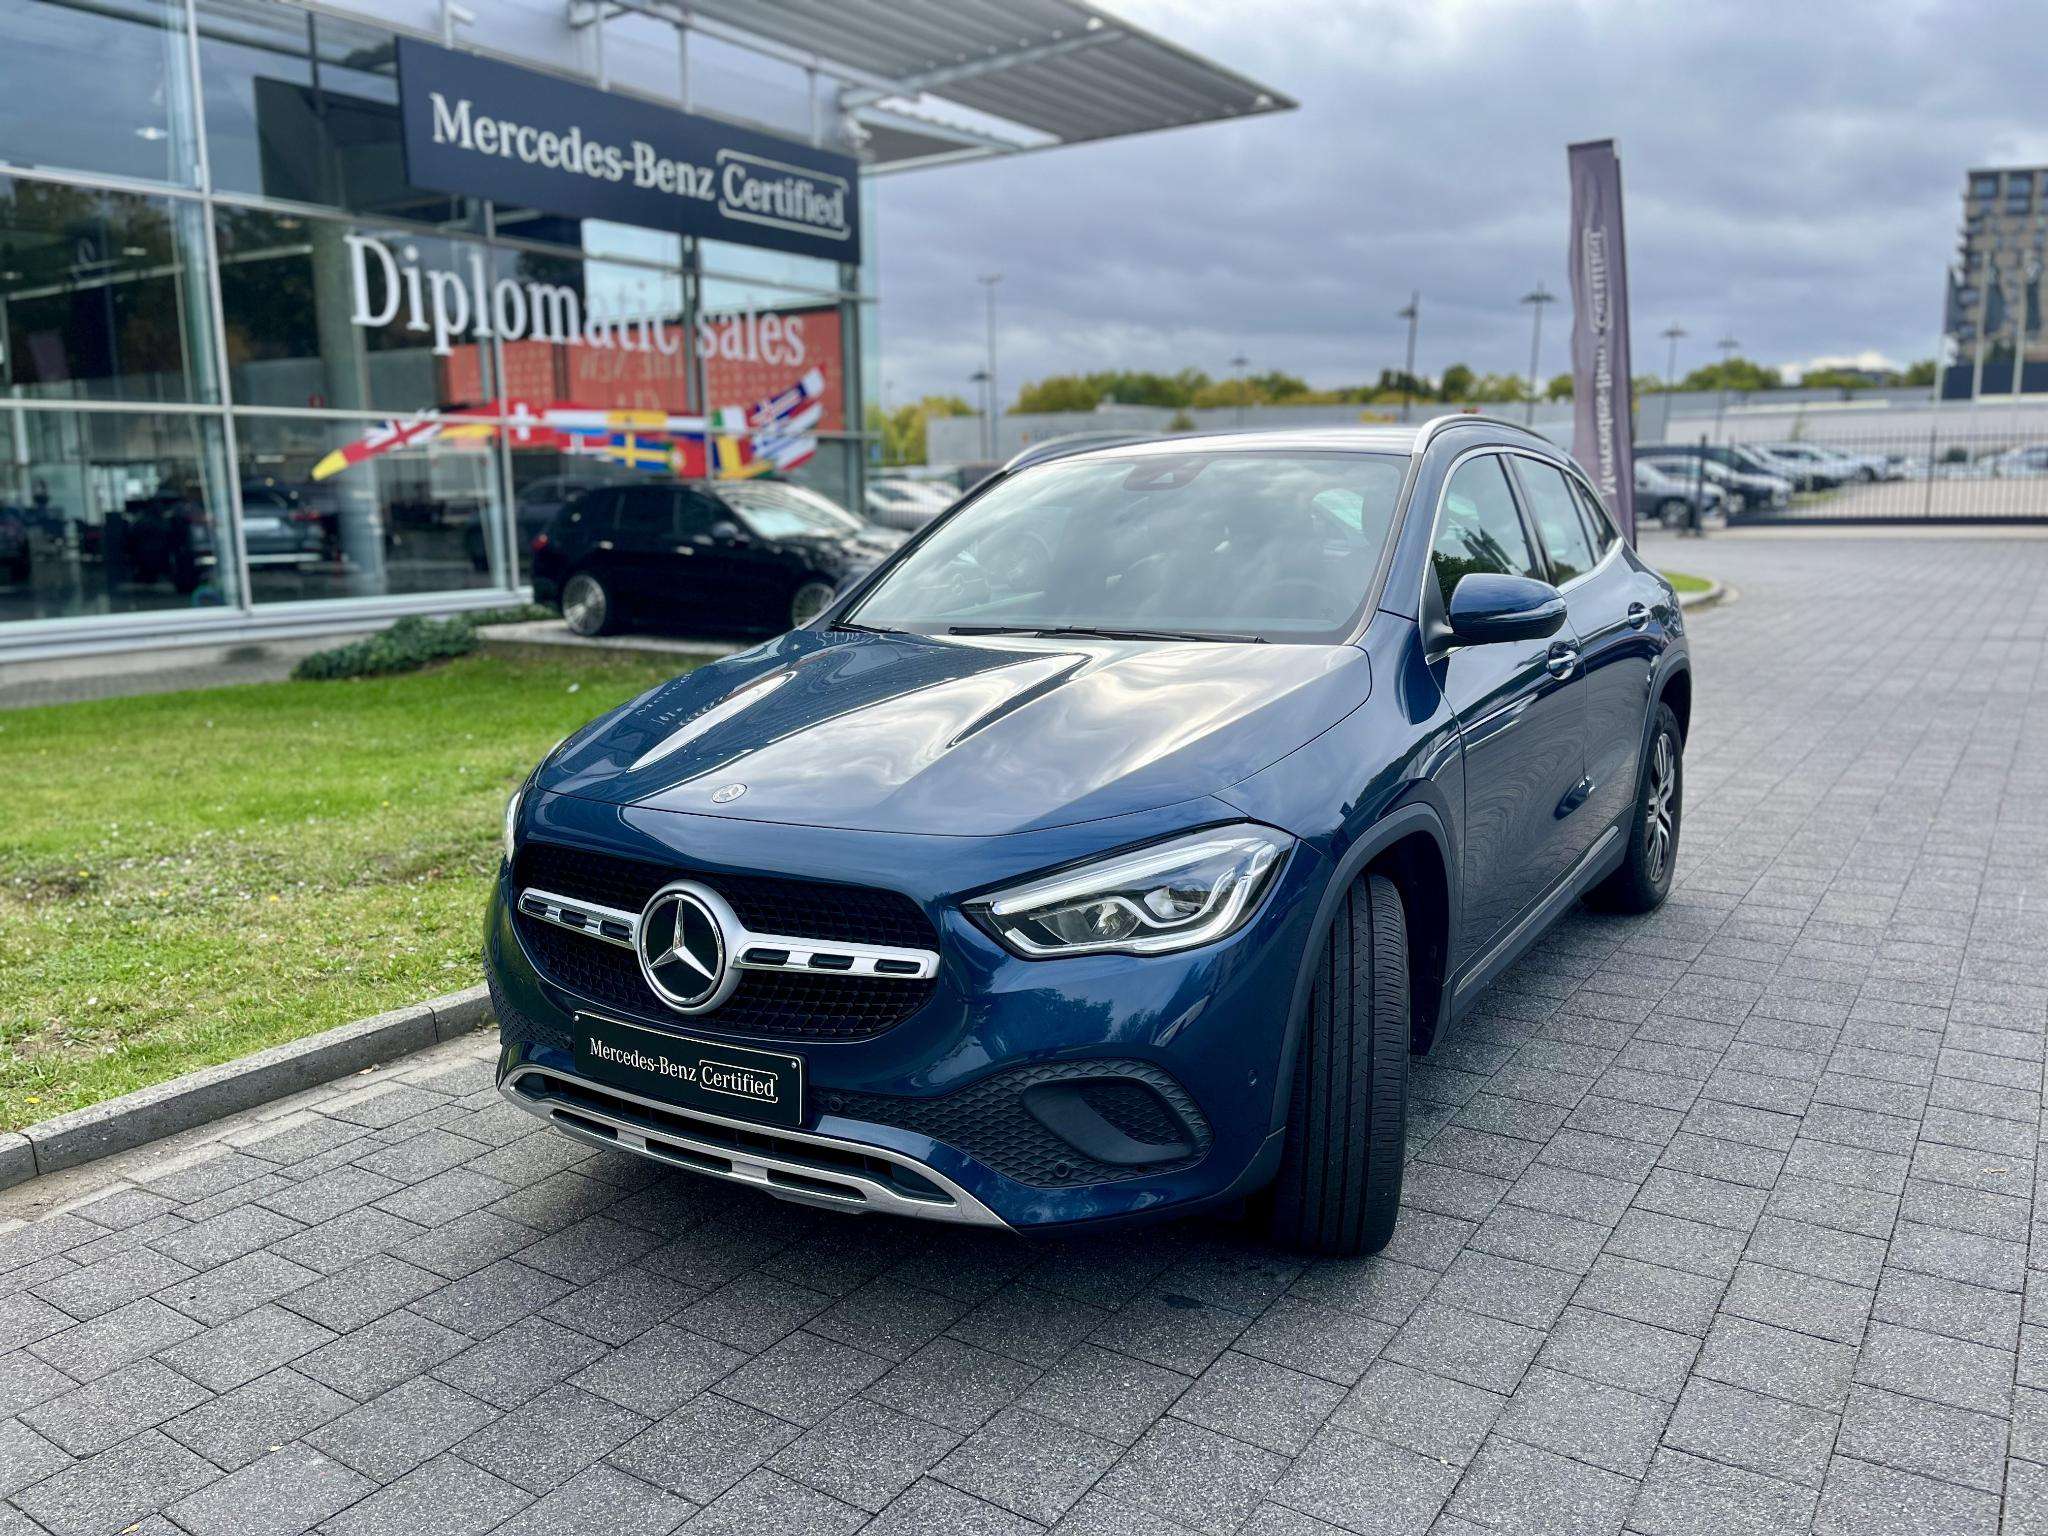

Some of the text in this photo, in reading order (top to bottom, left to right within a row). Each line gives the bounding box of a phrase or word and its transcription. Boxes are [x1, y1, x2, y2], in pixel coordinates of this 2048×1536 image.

[430, 92, 845, 228] Mercedes-Benz Certified
[344, 235, 807, 367] Diplomatic sales
[589, 1037, 775, 1097] Mercedes-Benz Certified
